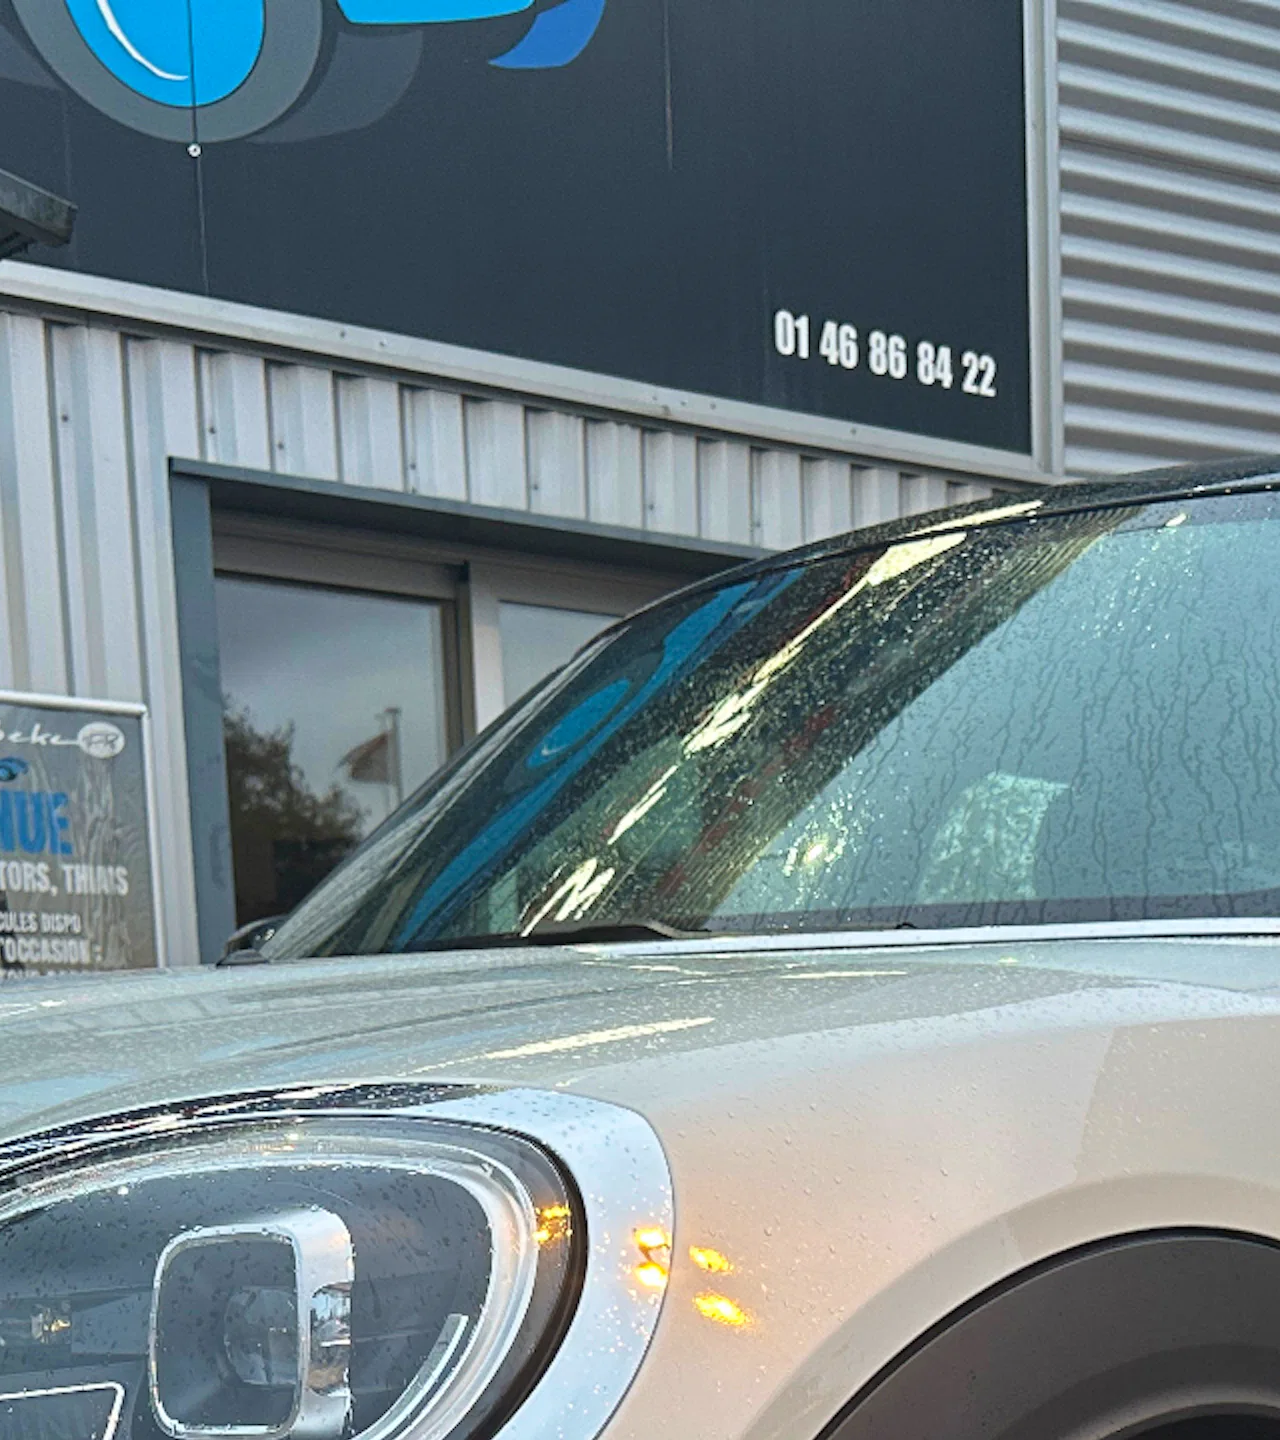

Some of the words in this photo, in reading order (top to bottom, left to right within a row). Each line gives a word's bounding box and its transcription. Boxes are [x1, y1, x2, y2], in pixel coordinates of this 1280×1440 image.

[774, 309, 810, 360] 01
[819, 320, 860, 370] 46
[868, 329, 908, 380] 86
[916, 340, 954, 389] 84
[961, 350, 998, 398] 22
[62, 863, 129, 896] THIAIS
